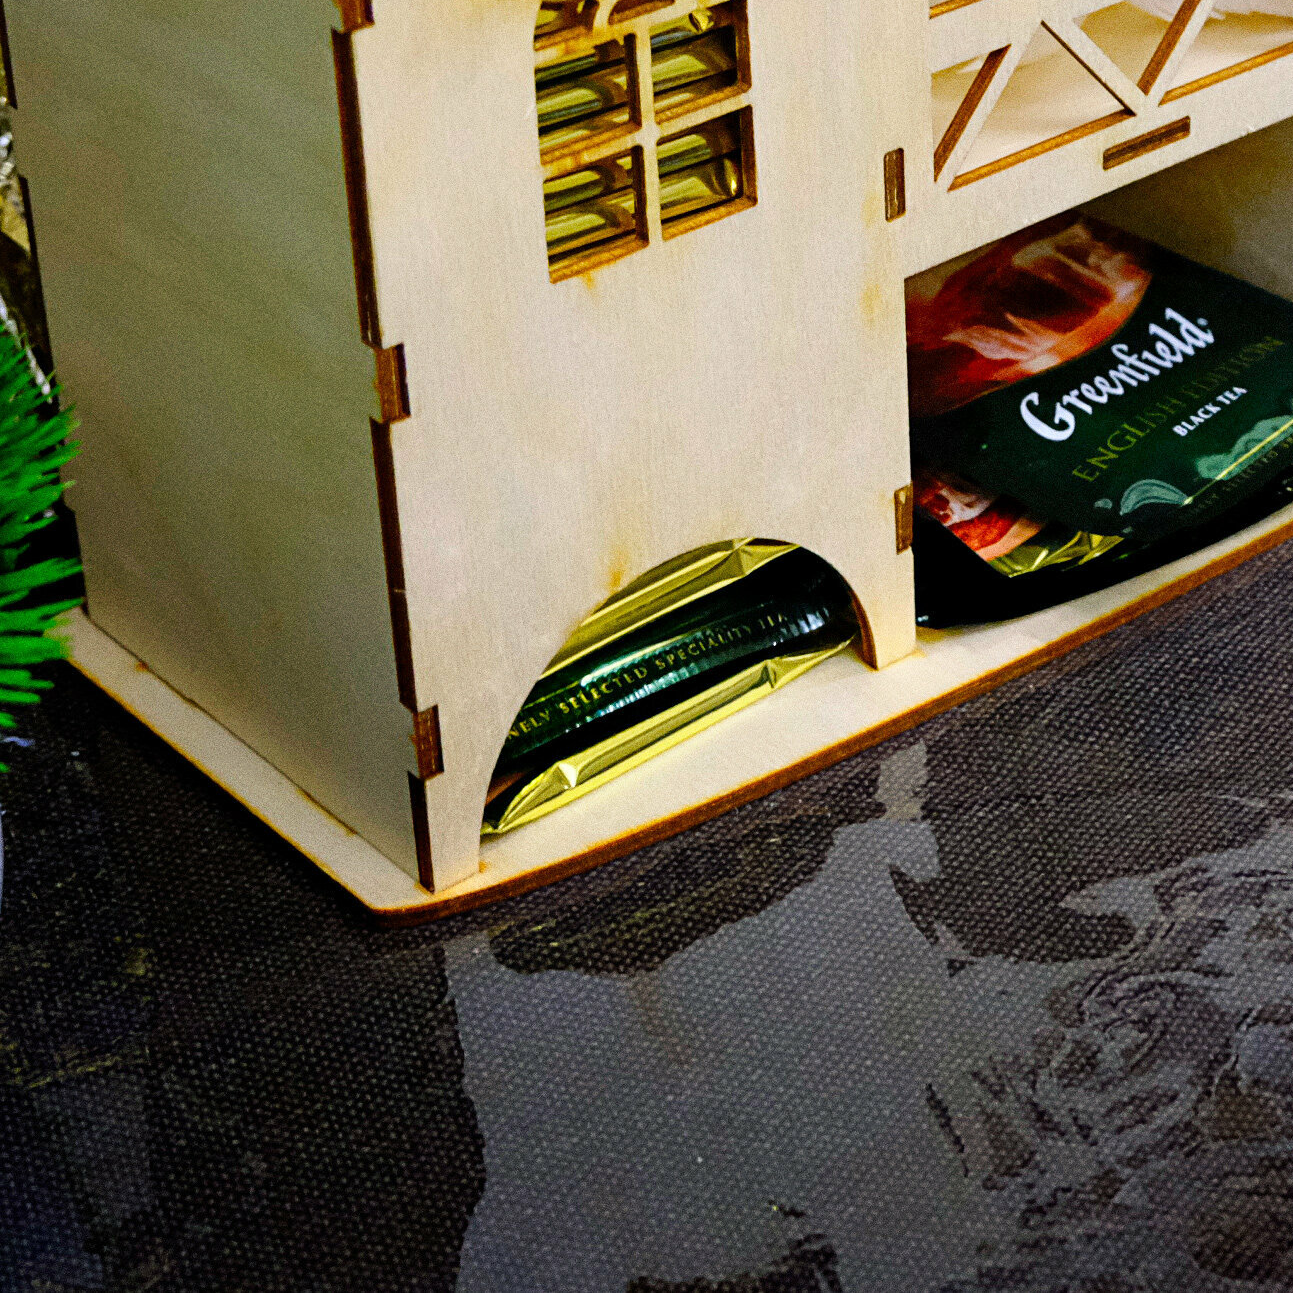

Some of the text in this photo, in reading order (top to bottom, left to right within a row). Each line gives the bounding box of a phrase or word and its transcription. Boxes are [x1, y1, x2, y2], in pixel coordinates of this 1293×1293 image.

[1020, 307, 1215, 442] Greenfield
[1172, 385, 1249, 438] BLACK TEA
[508, 709, 551, 740] NELY
[557, 665, 649, 714] SELECTED
